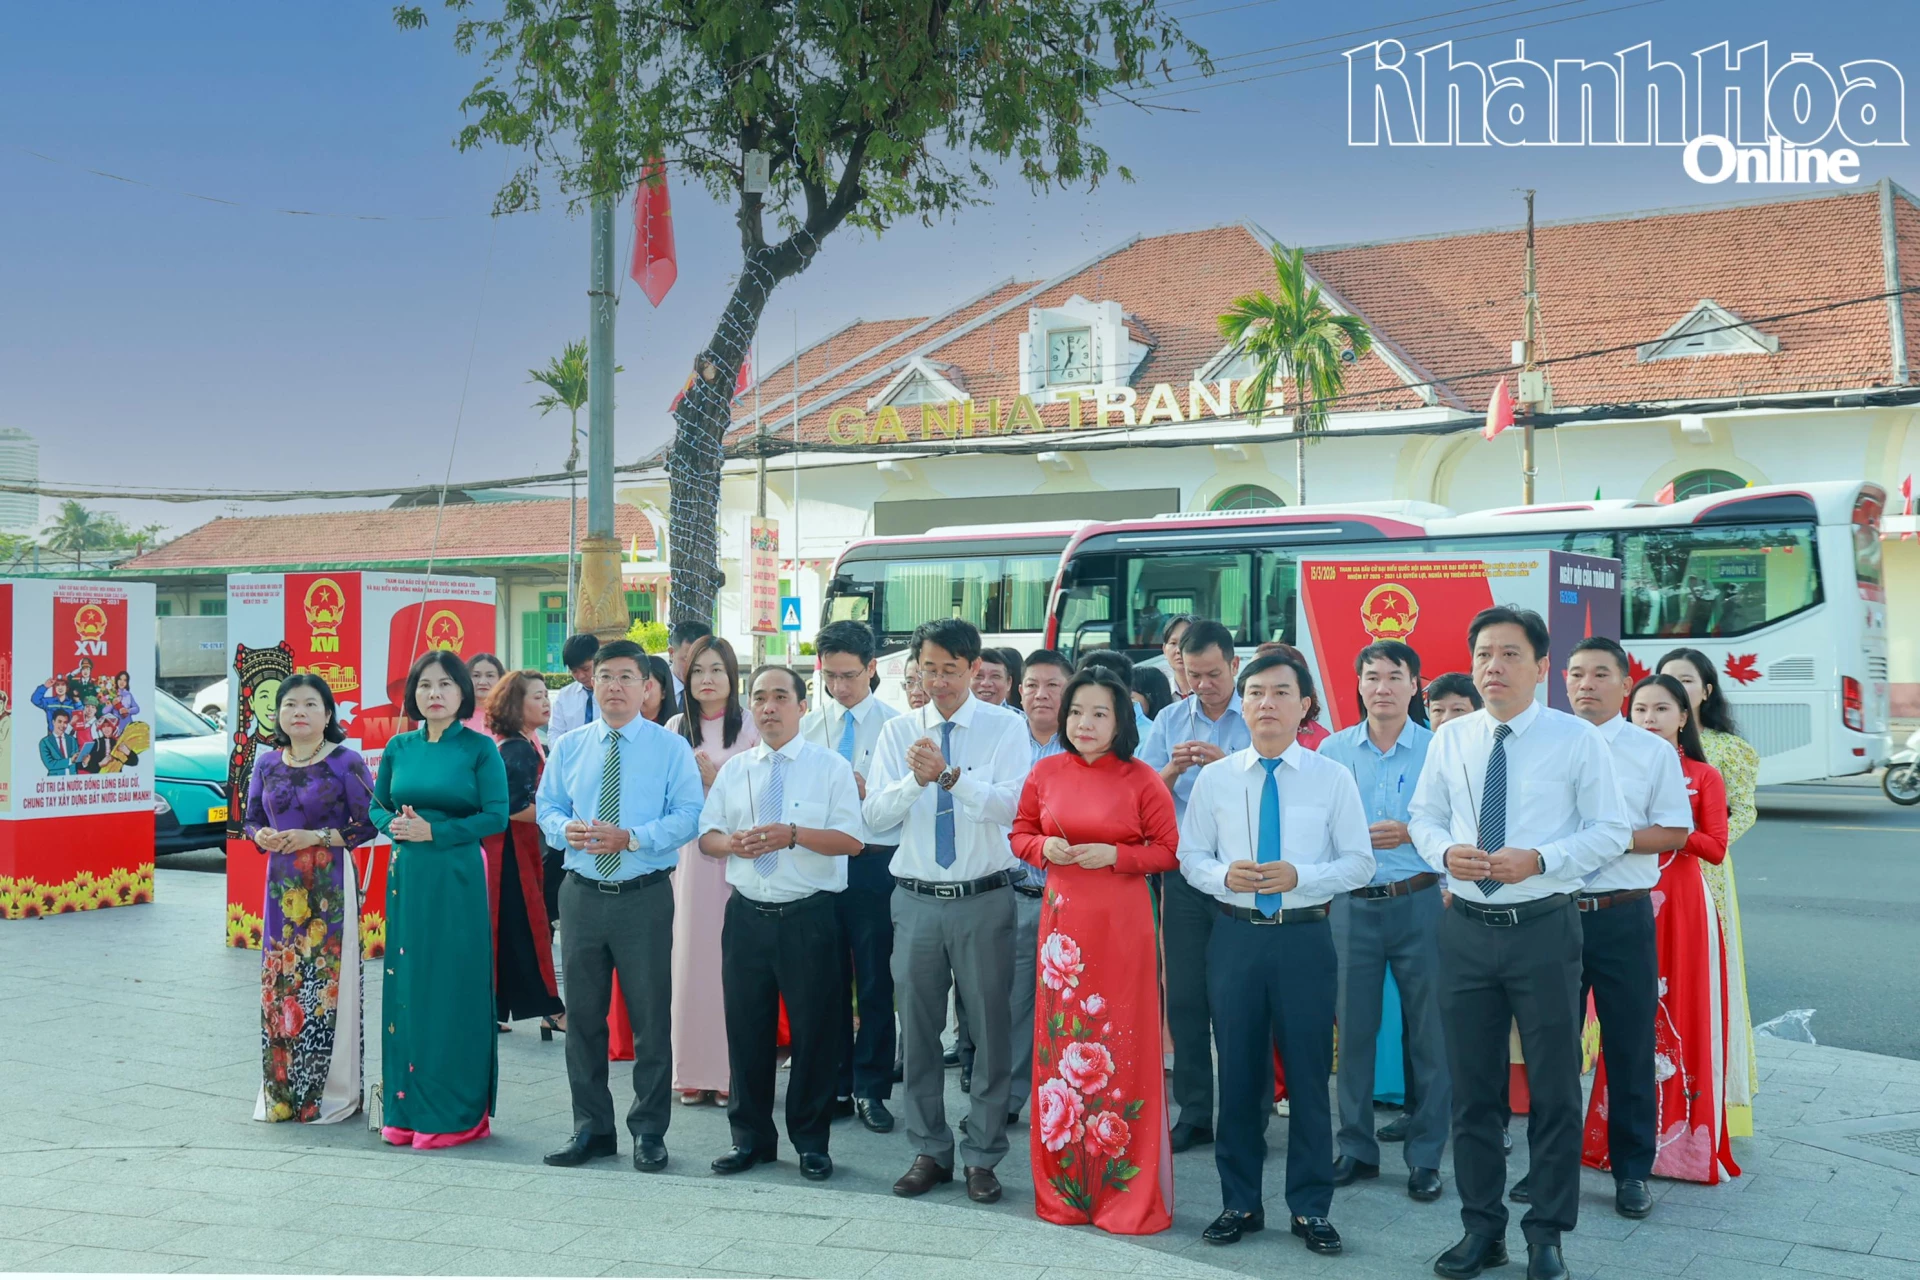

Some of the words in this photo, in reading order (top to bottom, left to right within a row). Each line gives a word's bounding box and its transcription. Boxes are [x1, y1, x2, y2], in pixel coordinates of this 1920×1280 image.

[827, 405, 907, 445] GA
[920, 392, 1045, 440] NHA
[1055, 376, 1285, 431] TRANG
[74, 640, 108, 656] XVI
[310, 636, 339, 652] XVI
[362, 716, 408, 742] XVI
[46, 782, 56, 792] TRI
[23, 797, 44, 809] CHUNG
[46, 796, 56, 807] TAY
